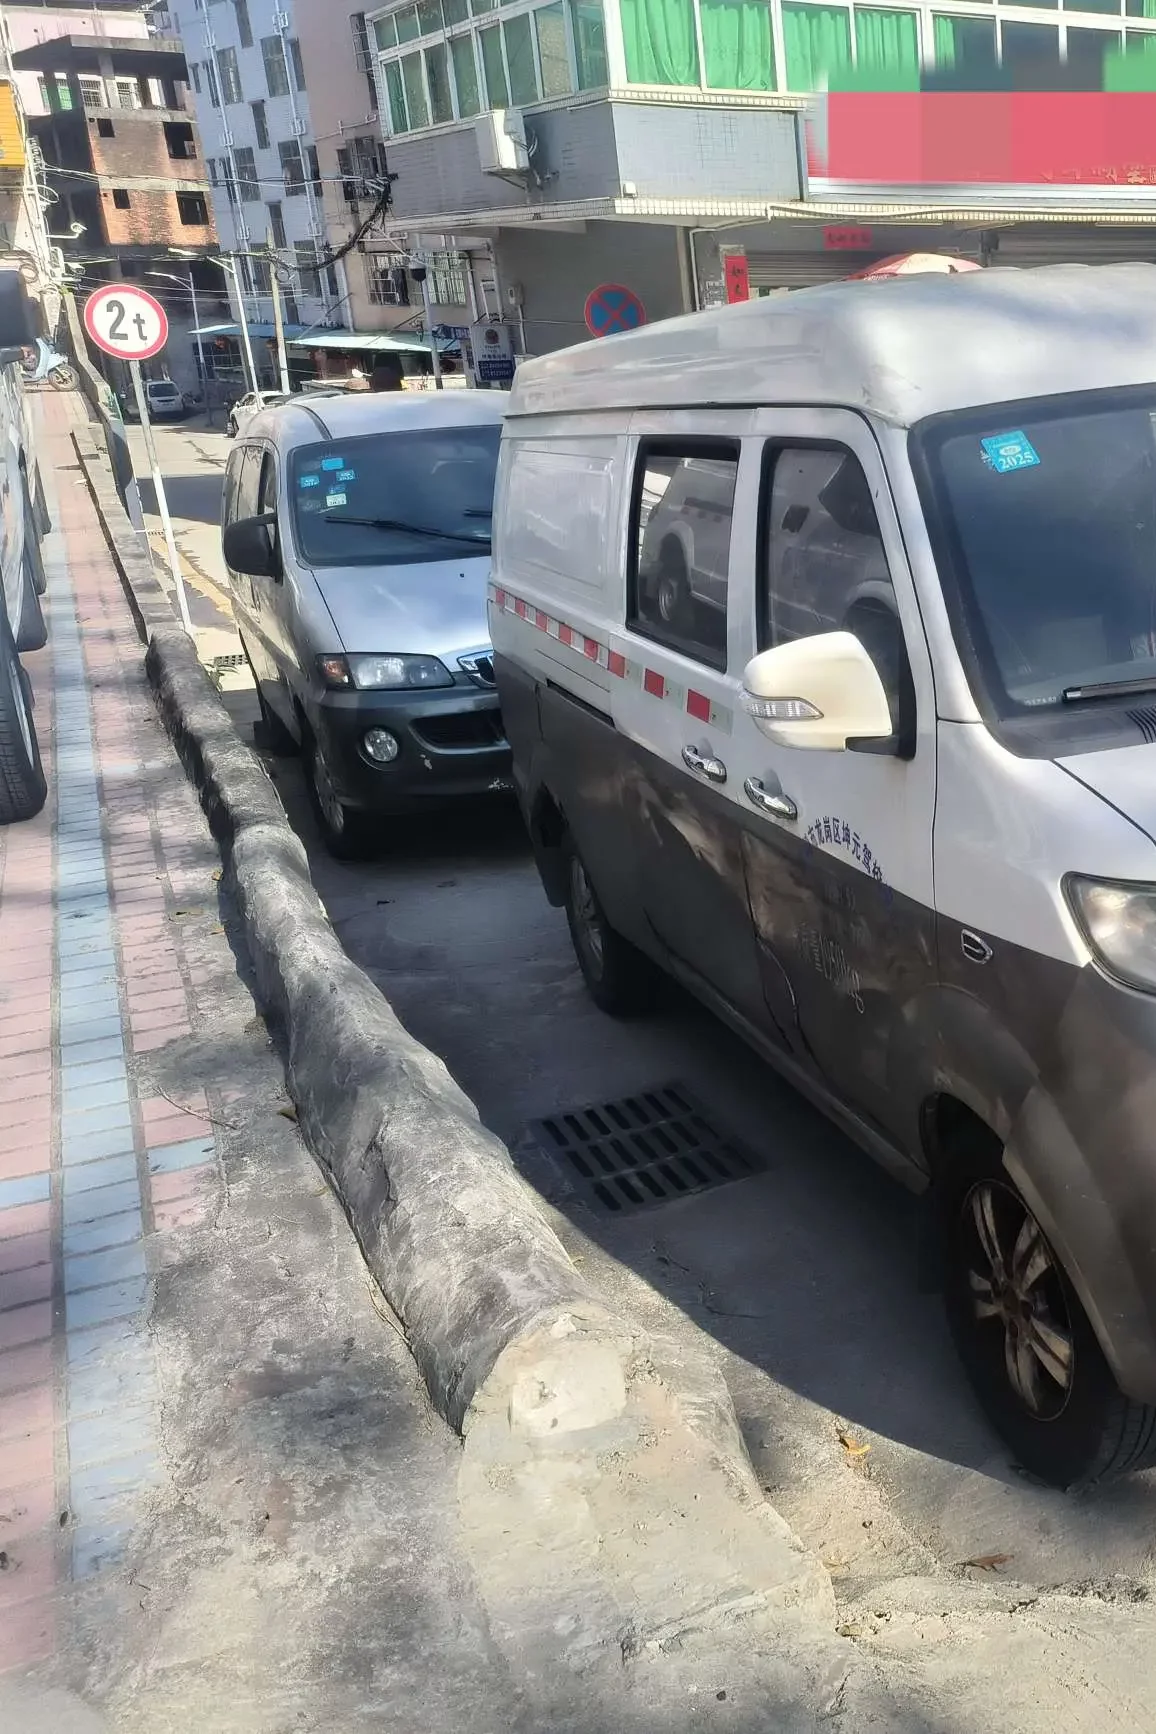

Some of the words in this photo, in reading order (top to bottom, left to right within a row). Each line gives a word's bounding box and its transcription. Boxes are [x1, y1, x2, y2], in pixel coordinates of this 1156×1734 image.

[998, 451, 1034, 469] 2025
[803, 815, 884, 884] 市龙岗区坤元驾校
